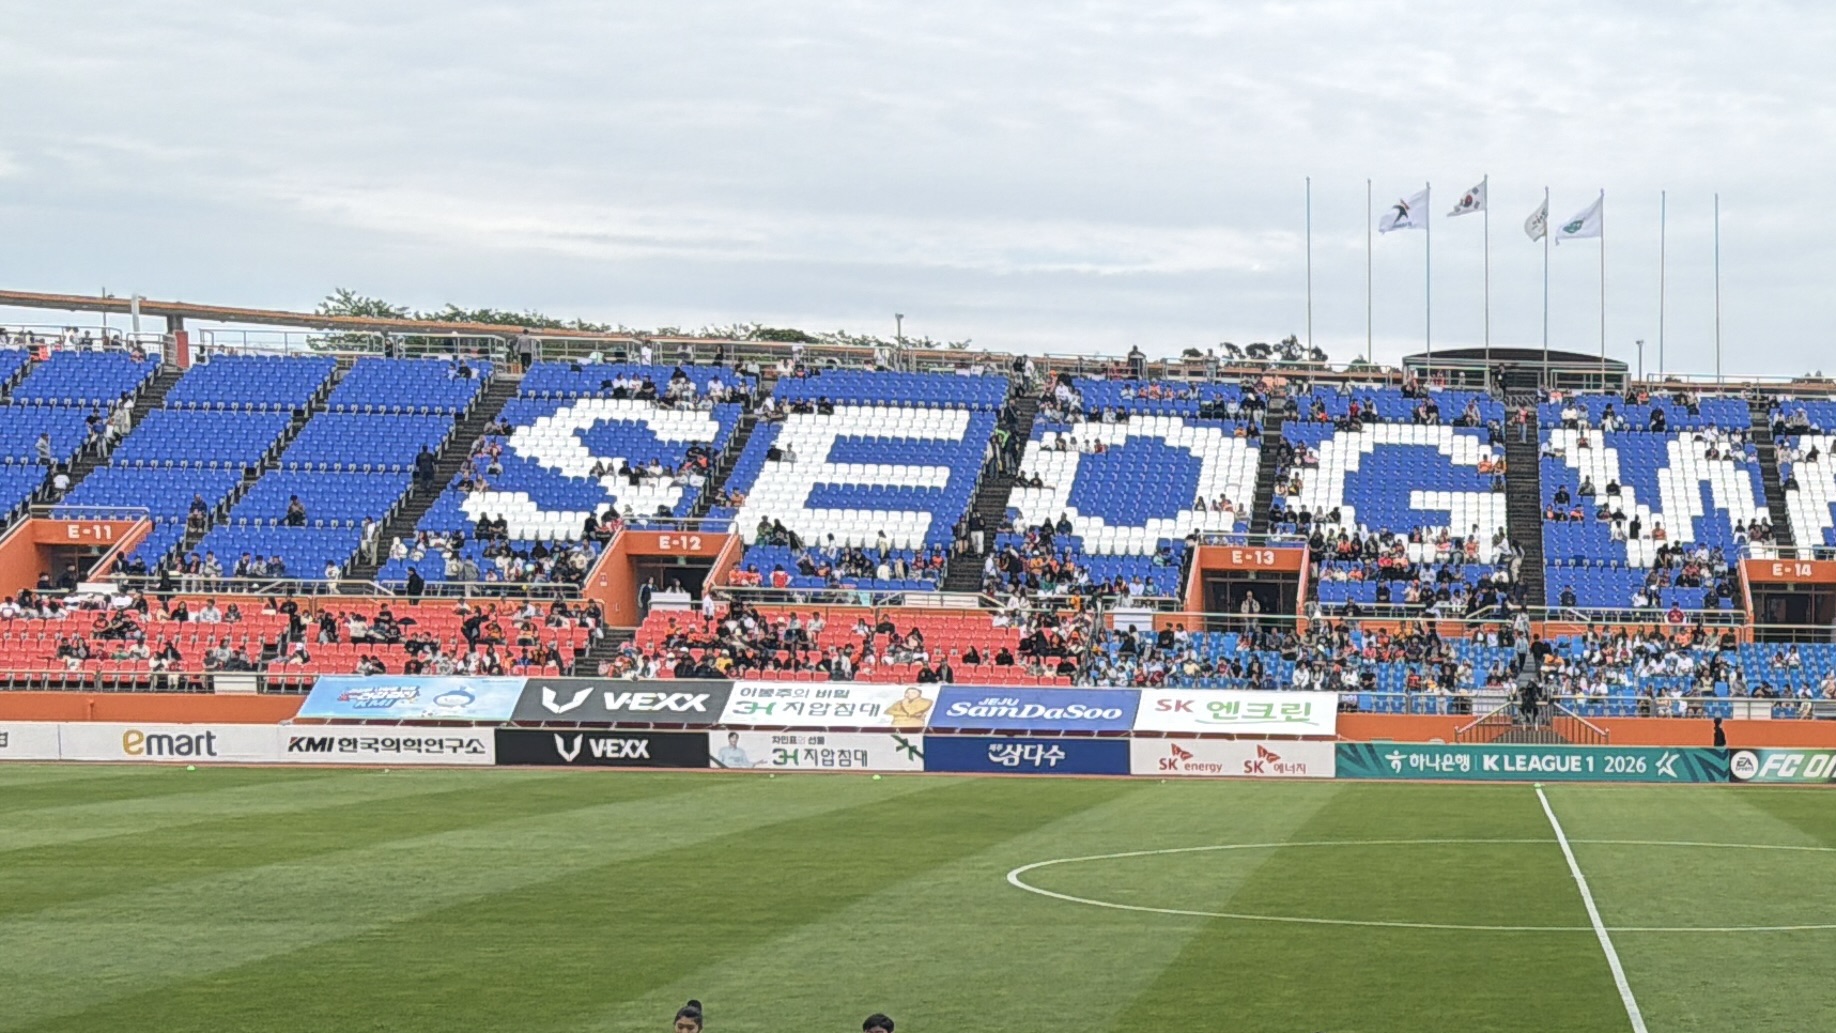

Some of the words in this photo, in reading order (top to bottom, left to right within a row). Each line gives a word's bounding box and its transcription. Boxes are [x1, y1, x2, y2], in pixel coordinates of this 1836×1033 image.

[67, 524, 112, 540] E-11
[659, 535, 702, 550] E-12
[1232, 550, 1275, 565] E-13
[1772, 563, 1812, 577] E-14
[604, 692, 711, 712] VEXX
[815, 689, 850, 699] 비밀
[978, 697, 1020, 706] JEJU
[732, 700, 777, 716] 3H
[782, 701, 881, 717] 지압침대
[946, 701, 1123, 720] SamDaSoo
[1154, 699, 1195, 713] SK
[1206, 700, 1312, 722] 엔크린
[122, 729, 217, 757] emart
[288, 737, 335, 752] KMI
[337, 737, 486, 753] 한국의학연구소
[589, 739, 651, 759] VEXX
[772, 748, 799, 766] 3H
[804, 748, 869, 767] 지압침대
[988, 744, 1065, 767] 삼다수
[1409, 753, 1471, 773] 하나은행
[1483, 754, 1499, 771] K
[1504, 755, 1581, 772] LEAGUE
[1586, 755, 1594, 772] 1
[1604, 756, 1647, 773] 2026
[1159, 758, 1178, 770] SK
[1184, 763, 1223, 773] energy
[1244, 760, 1265, 773] SK
[1274, 763, 1307, 774] 에너지
[1758, 754, 1805, 777] FC
